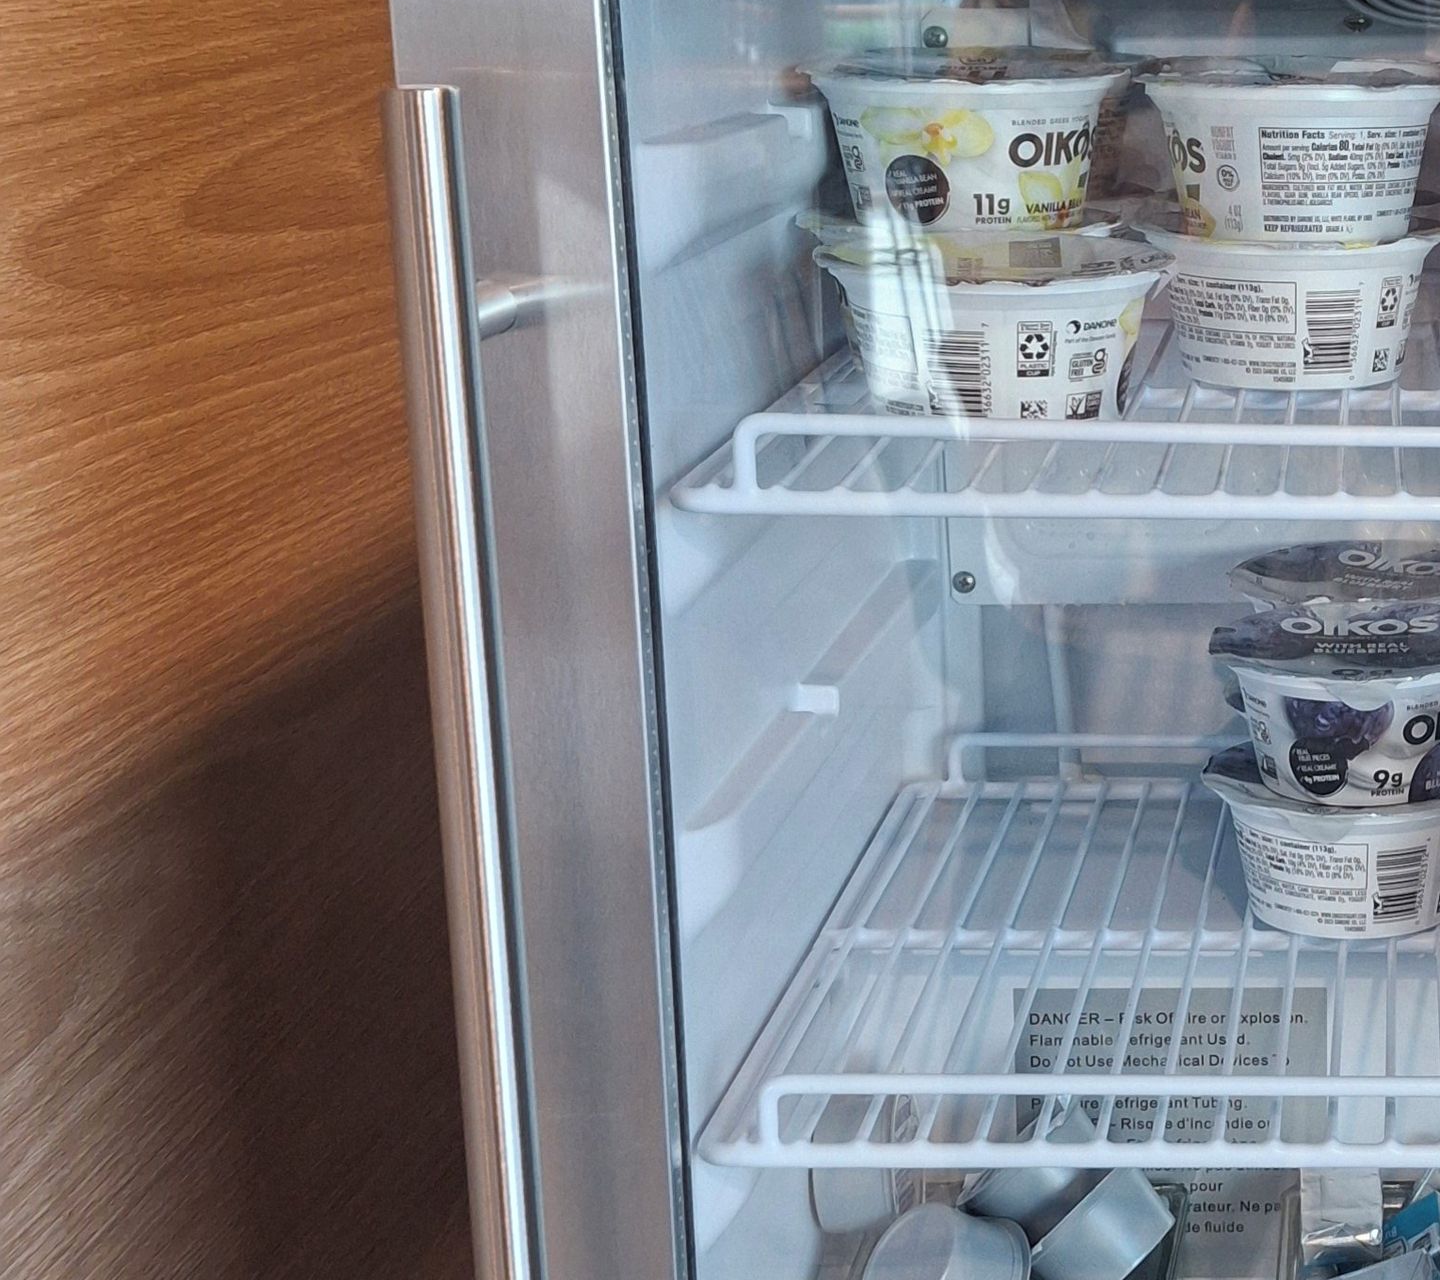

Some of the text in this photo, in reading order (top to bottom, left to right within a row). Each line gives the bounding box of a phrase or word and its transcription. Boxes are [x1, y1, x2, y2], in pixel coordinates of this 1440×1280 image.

[1261, 130, 1299, 139] Nutrition
[1302, 130, 1325, 139] Facts
[973, 193, 1011, 216] 11g
[1026, 201, 1067, 214] VANILLA
[975, 216, 1012, 225] PROTEIN
[1083, 319, 1113, 331] DANONE
[1280, 614, 1440, 637] OIKOS
[1370, 641, 1407, 649] REAL
[1313, 774, 1340, 784] PROTEIN
[1373, 769, 1404, 791] 9g
[1371, 788, 1405, 797] PROTEIN
[1211, 1014, 1226, 1024] or
[1130, 1033, 1250, 1049] efrigeant Usd.
[1030, 1055, 1051, 1068] Do
[1086, 1055, 1114, 1068] Use
[1115, 1096, 1188, 1112] efrigeant
[1121, 1117, 1174, 1132] Risqe
[1189, 1181, 1224, 1196] pour
[1240, 1200, 1260, 1212] Ne
[1204, 1221, 1245, 1233] fluide
